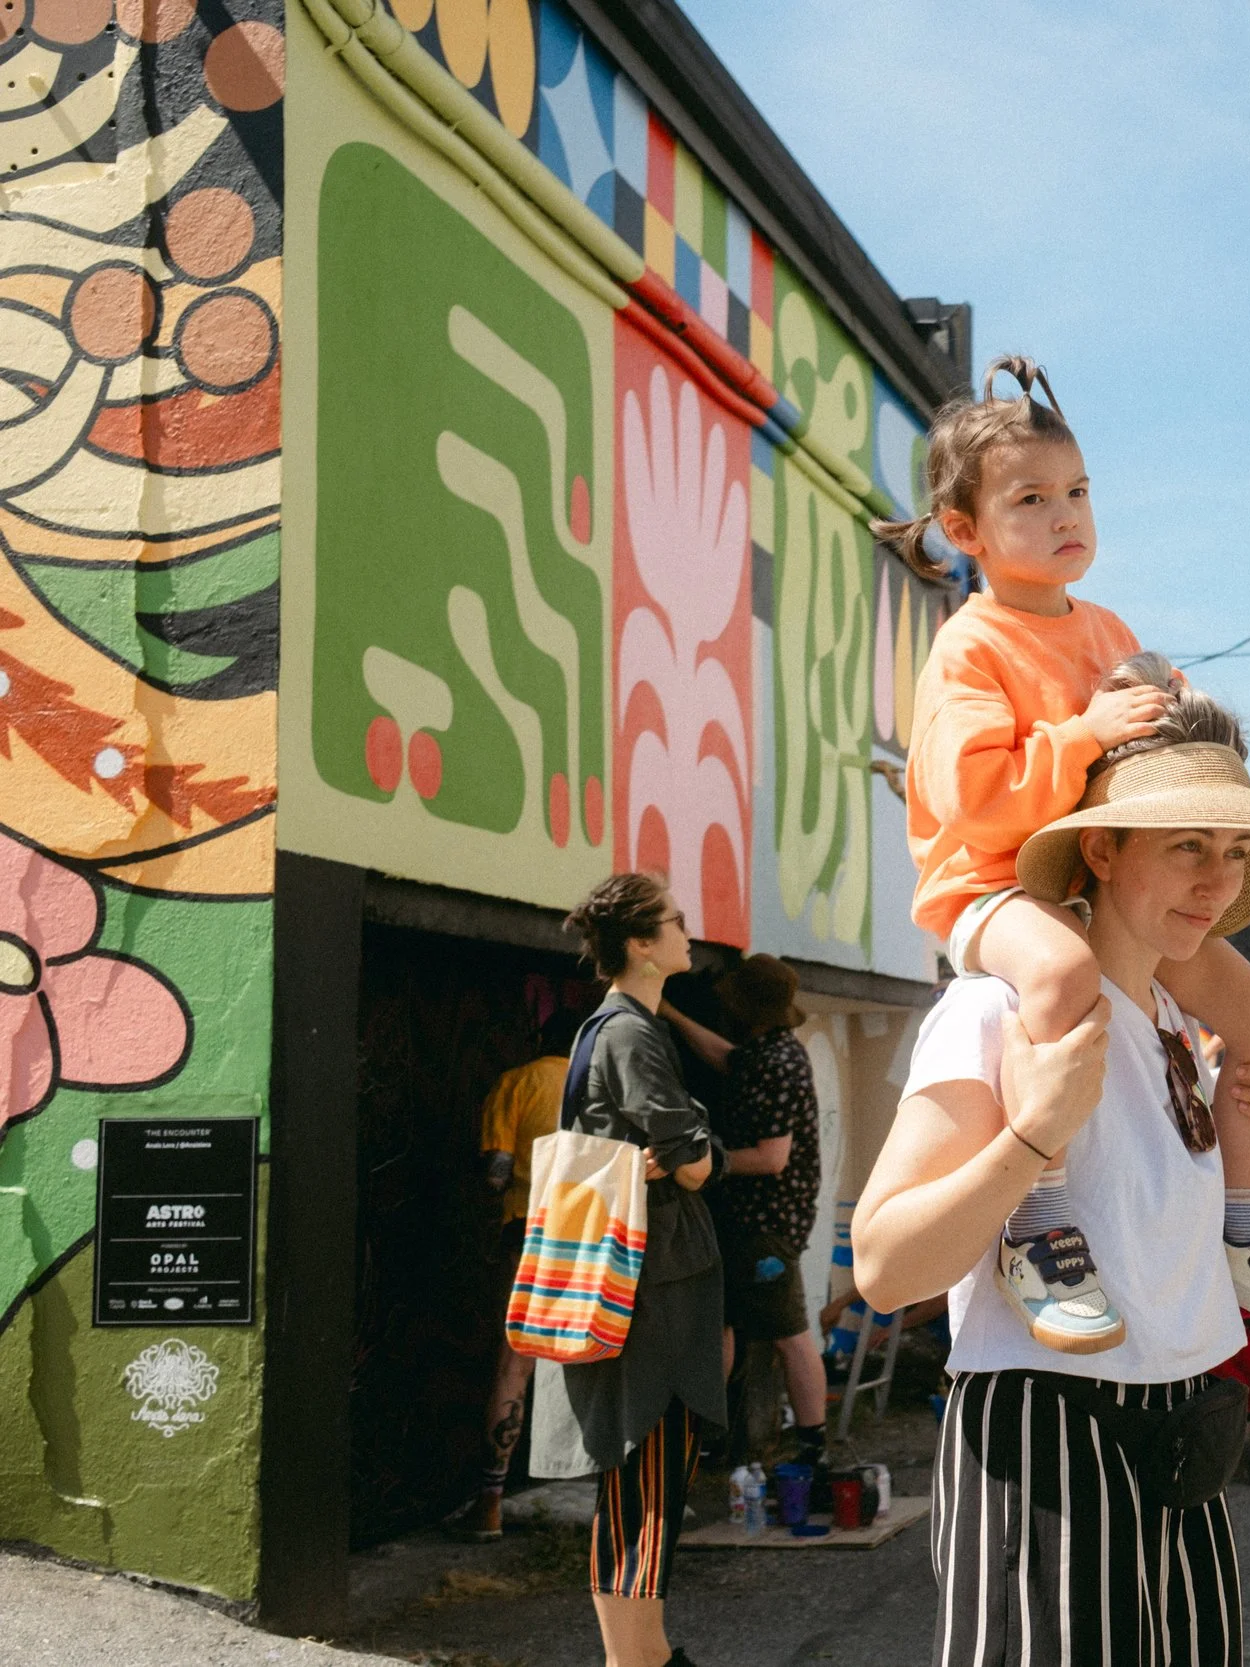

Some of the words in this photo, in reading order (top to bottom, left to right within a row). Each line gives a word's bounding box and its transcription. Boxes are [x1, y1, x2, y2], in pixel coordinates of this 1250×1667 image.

[146, 1205, 206, 1220] ASTRO
[168, 1220, 206, 1228] FESTIVAL
[150, 1253, 199, 1265] OPAL
